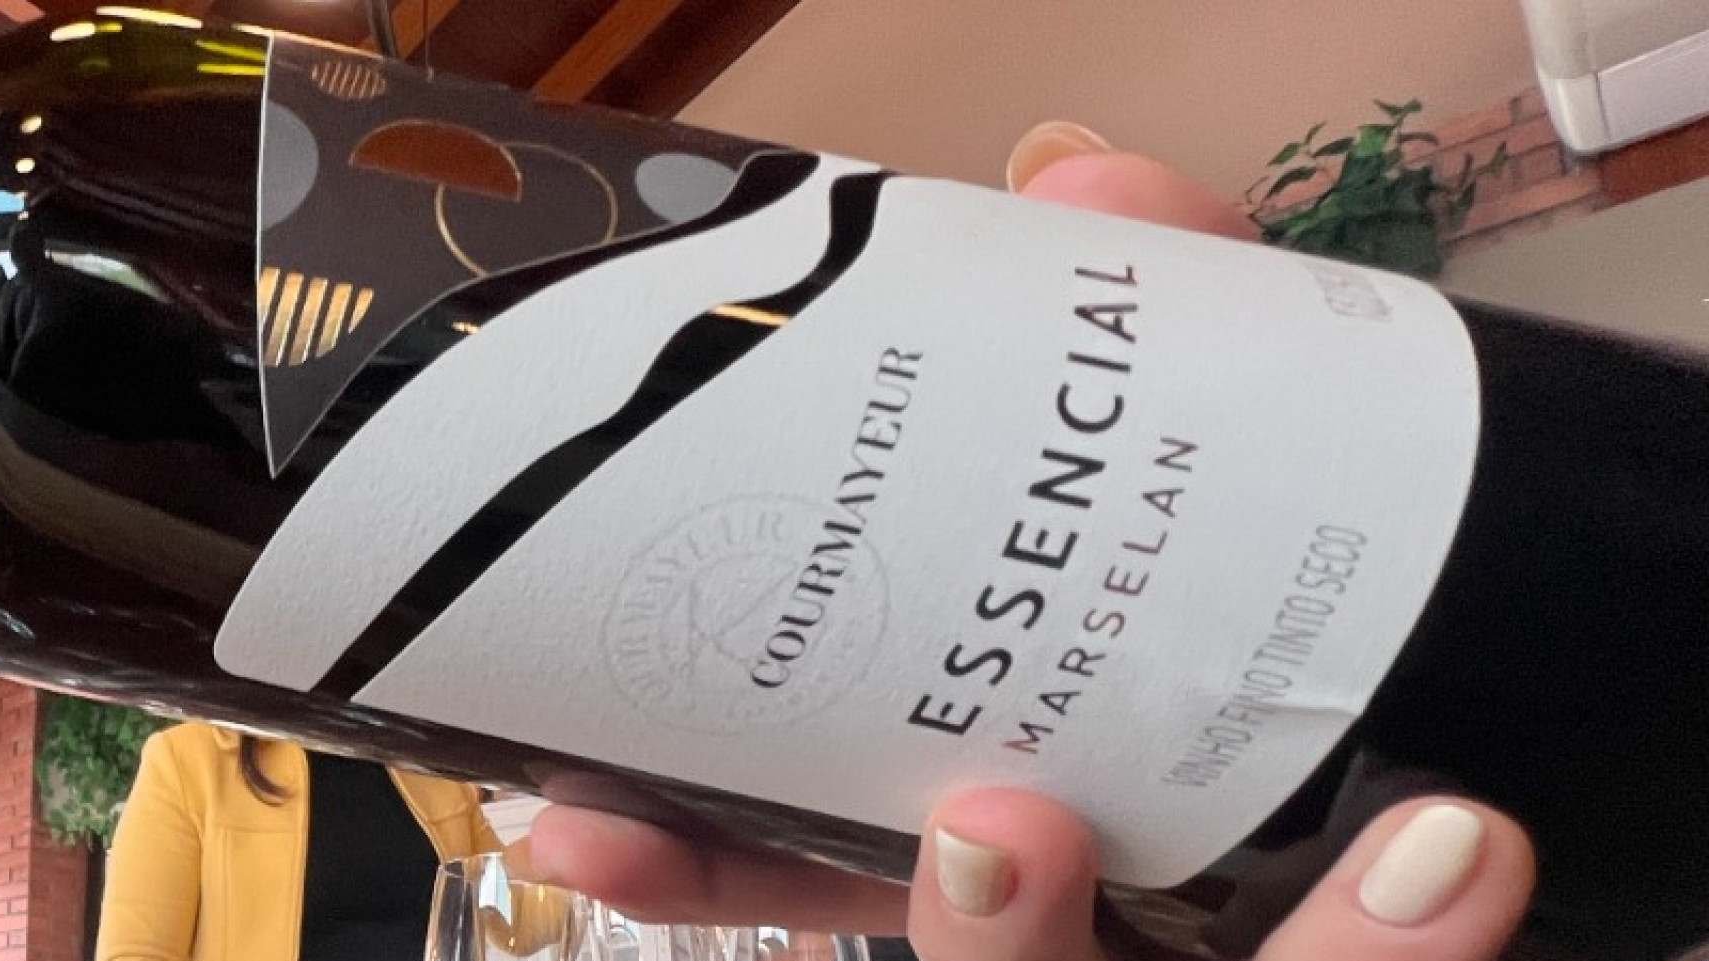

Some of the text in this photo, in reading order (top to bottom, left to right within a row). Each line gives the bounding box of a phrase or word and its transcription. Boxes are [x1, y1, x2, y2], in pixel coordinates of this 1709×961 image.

[751, 347, 923, 688] COURMAYEUR
[909, 264, 1139, 736] ESSENCIAL
[1006, 437, 1199, 755] MARSELAN
[1161, 524, 1367, 786] VINHO FINO TINTO SECO
